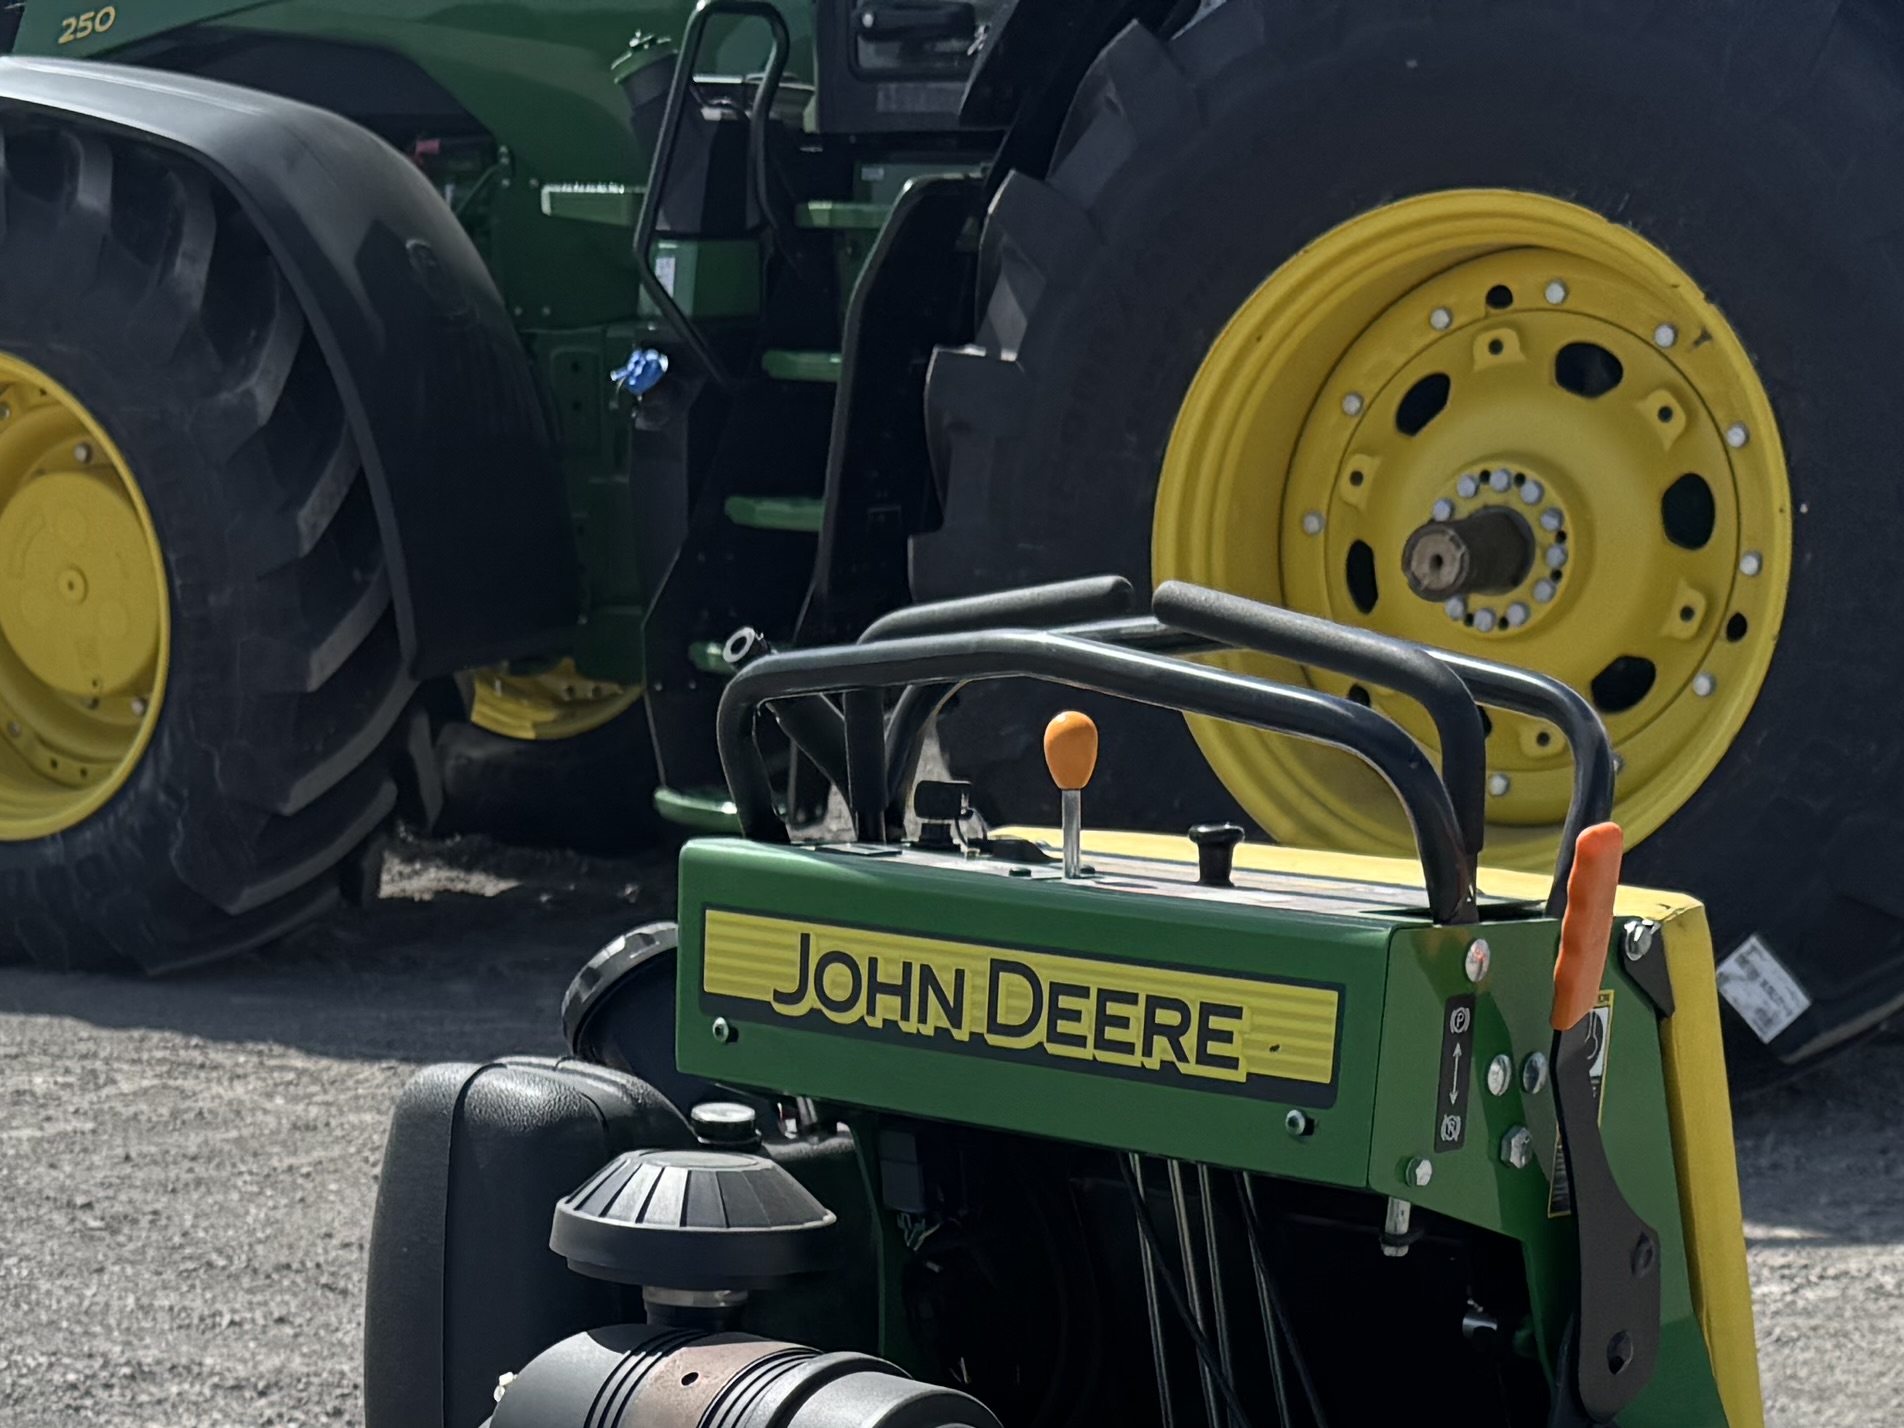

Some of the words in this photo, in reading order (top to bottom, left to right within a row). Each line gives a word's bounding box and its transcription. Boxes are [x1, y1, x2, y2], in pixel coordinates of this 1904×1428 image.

[57, 6, 116, 44] 250
[772, 931, 964, 1031] JOHN
[985, 958, 1243, 1070] DEERE
